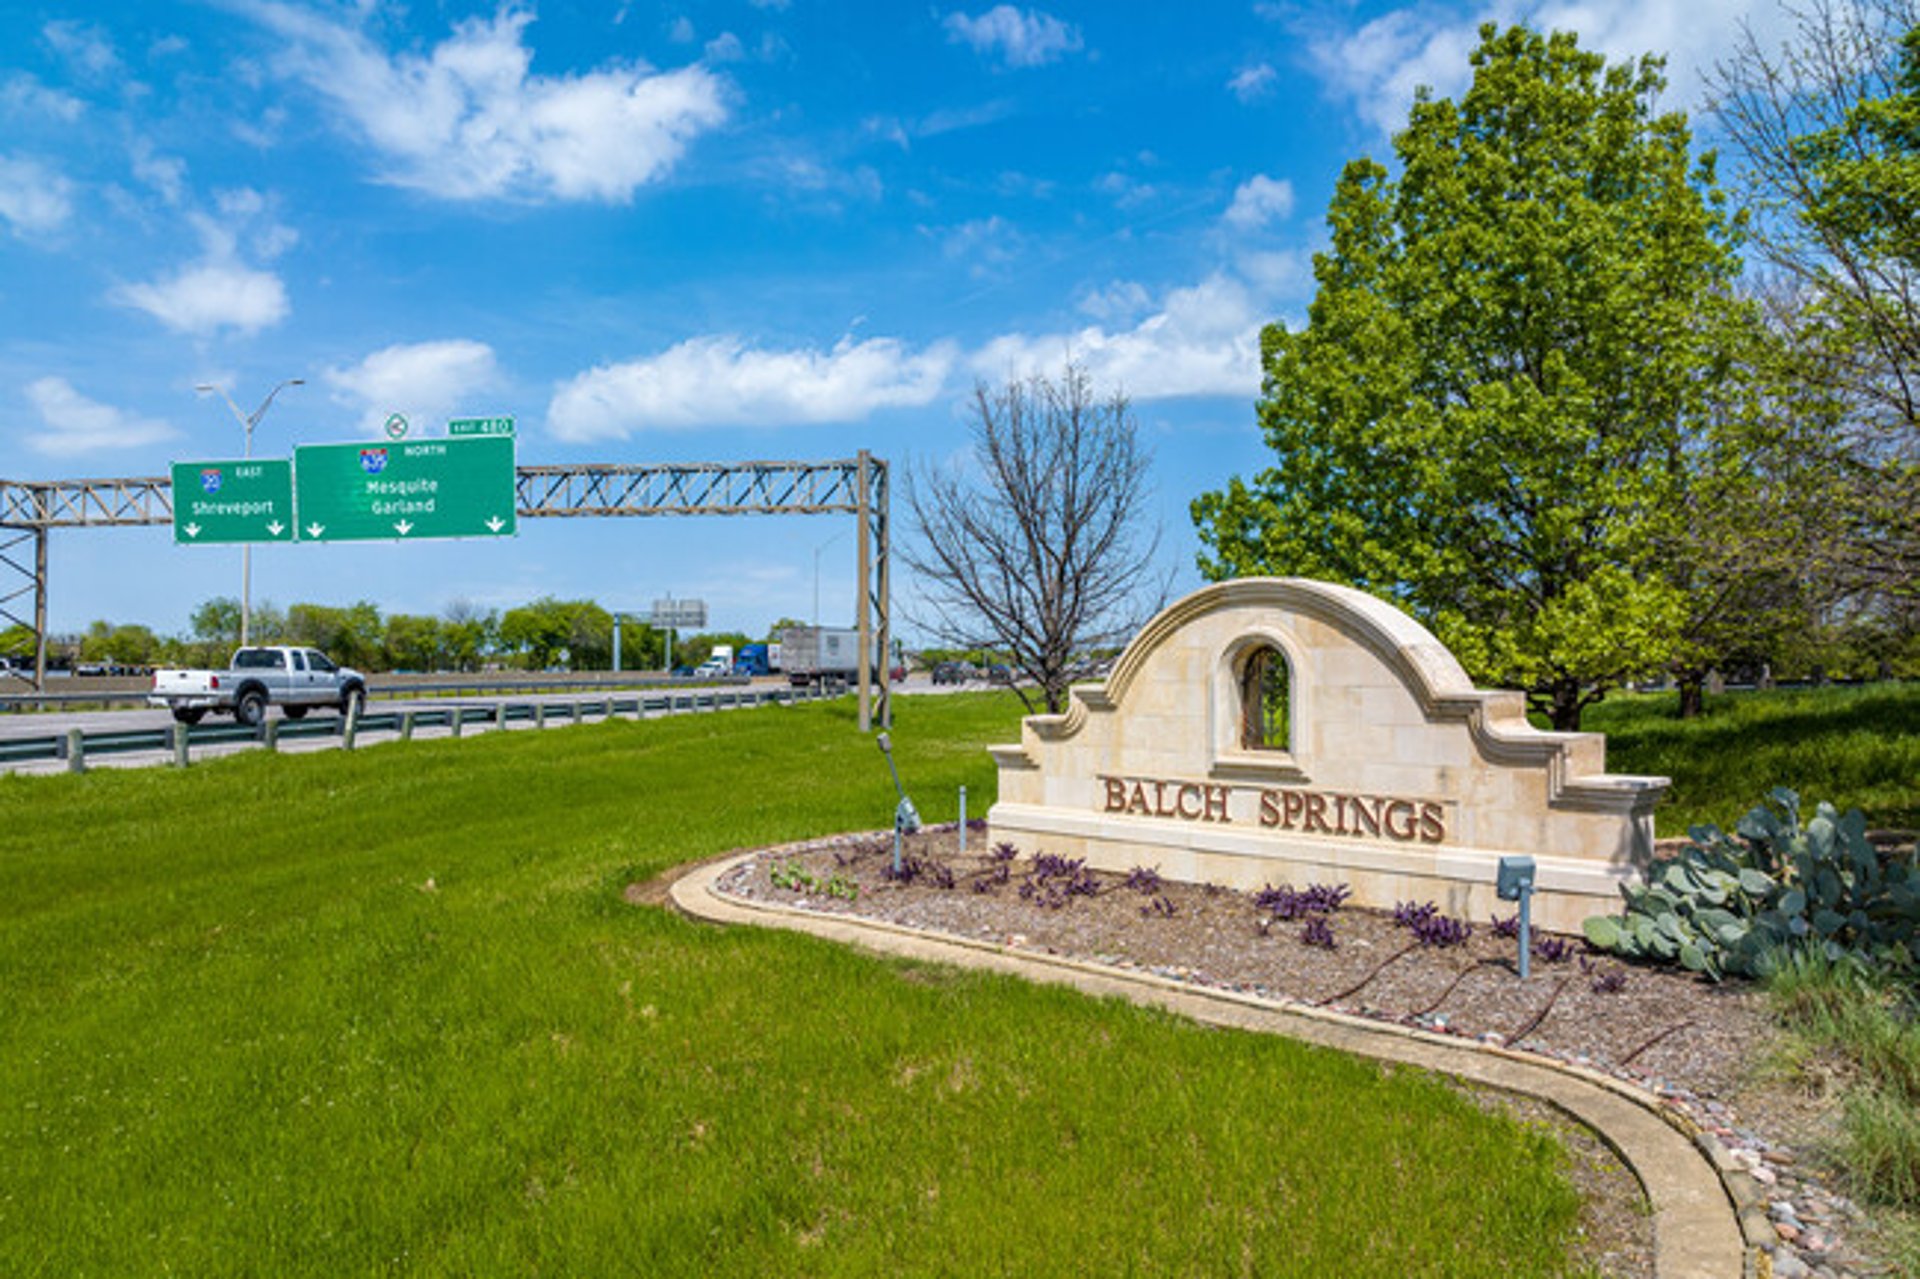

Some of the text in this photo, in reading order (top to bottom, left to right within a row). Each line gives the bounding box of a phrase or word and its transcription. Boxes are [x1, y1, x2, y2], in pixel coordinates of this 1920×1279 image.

[404, 446, 447, 457] NORTH
[235, 466, 262, 477] EAST
[366, 479, 437, 495] Mesquite
[192, 501, 272, 516] Shreveport
[372, 498, 436, 514] Garland
[1104, 777, 1446, 844] BALCH SPRINGS
